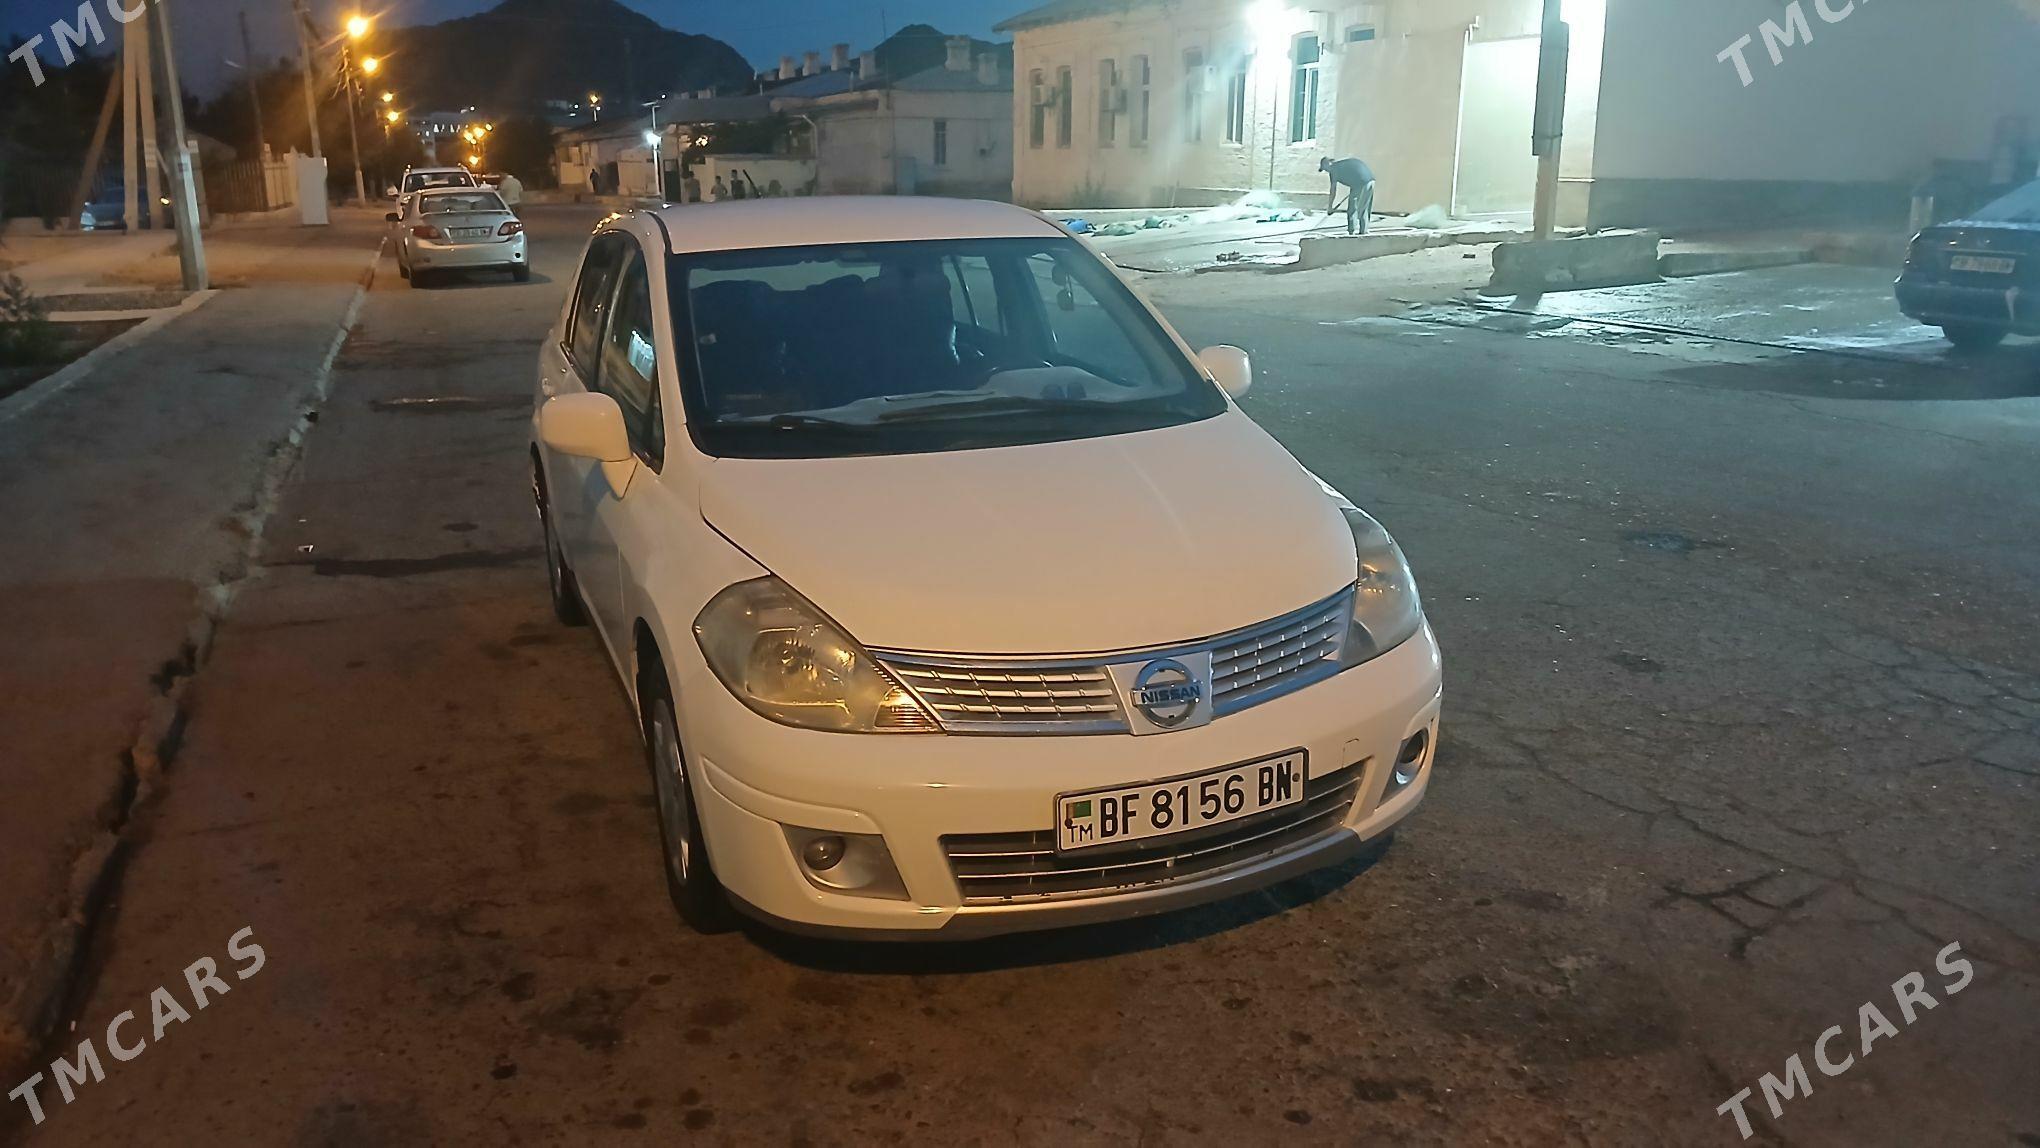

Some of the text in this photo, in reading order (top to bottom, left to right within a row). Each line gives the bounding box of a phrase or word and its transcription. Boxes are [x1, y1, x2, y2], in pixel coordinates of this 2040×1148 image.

[1140, 685, 1201, 704] NISSAN
[1100, 760, 1292, 838] BF 8156 BN
[1068, 823, 1094, 843] TM
